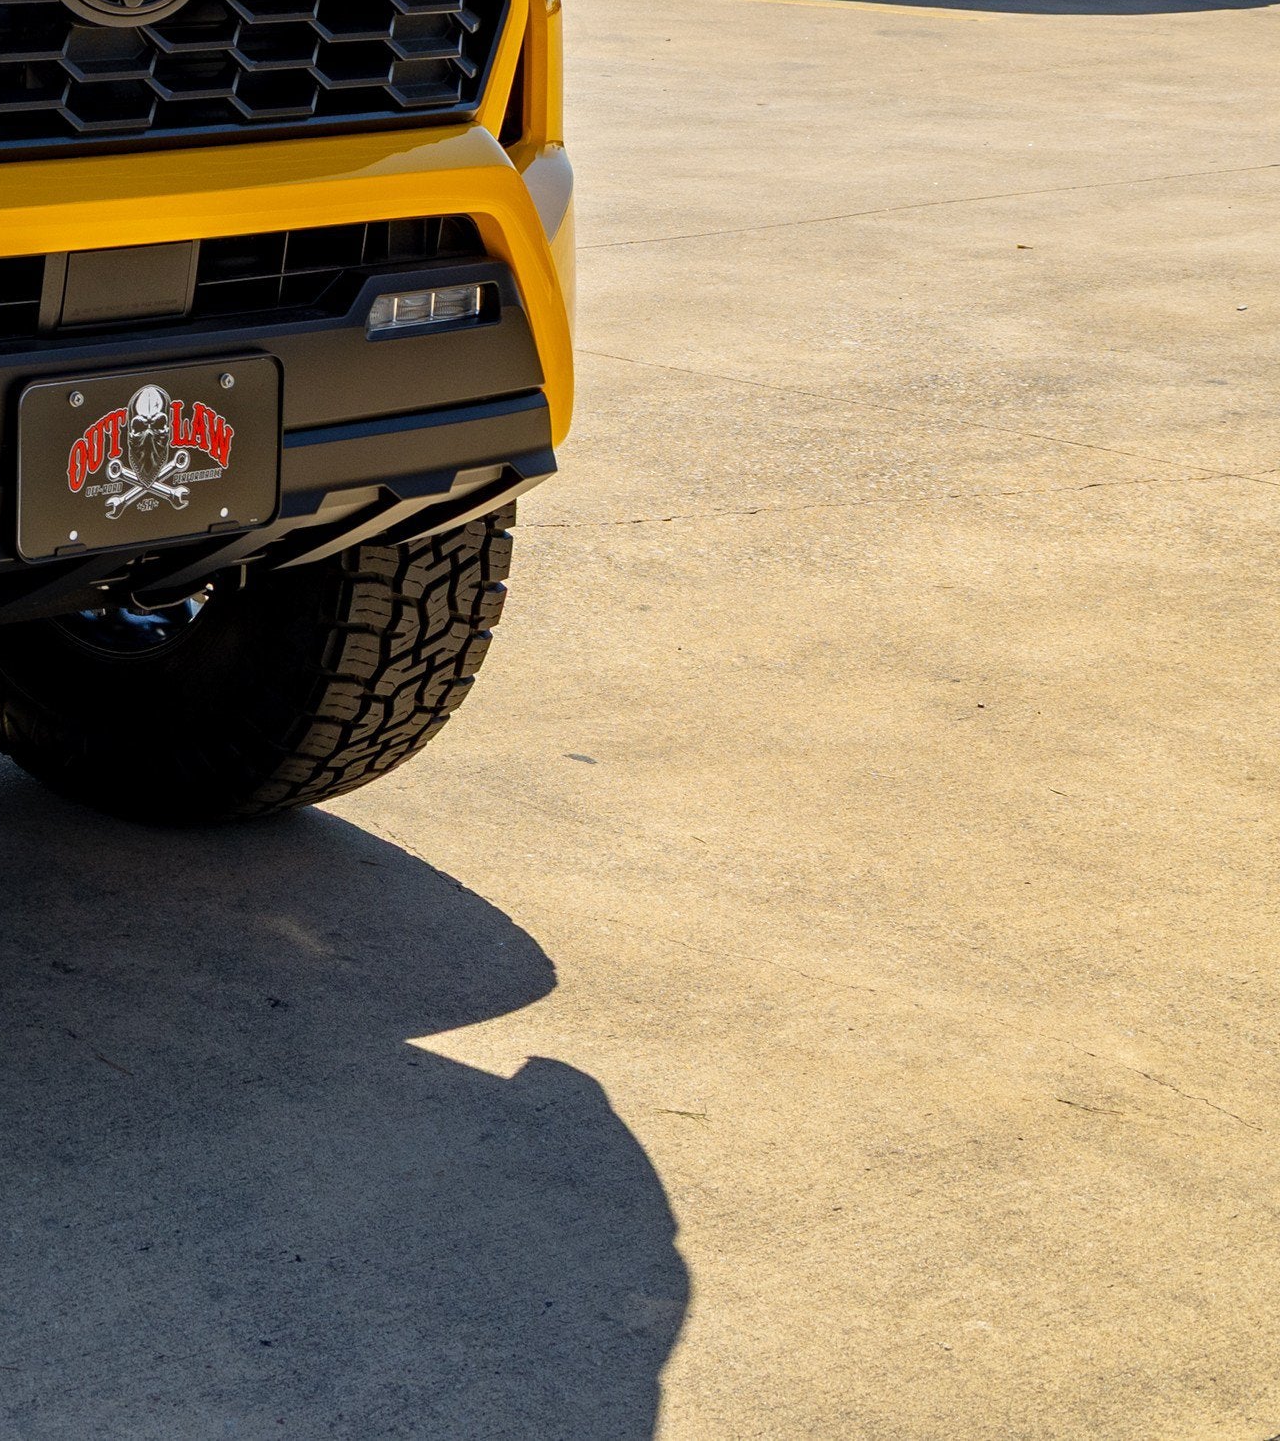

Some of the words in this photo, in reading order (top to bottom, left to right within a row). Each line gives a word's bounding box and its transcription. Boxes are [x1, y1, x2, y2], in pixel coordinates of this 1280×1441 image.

[67, 408, 128, 492] OUT
[170, 400, 234, 469] LAW
[85, 482, 124, 498] OFF-ROAD
